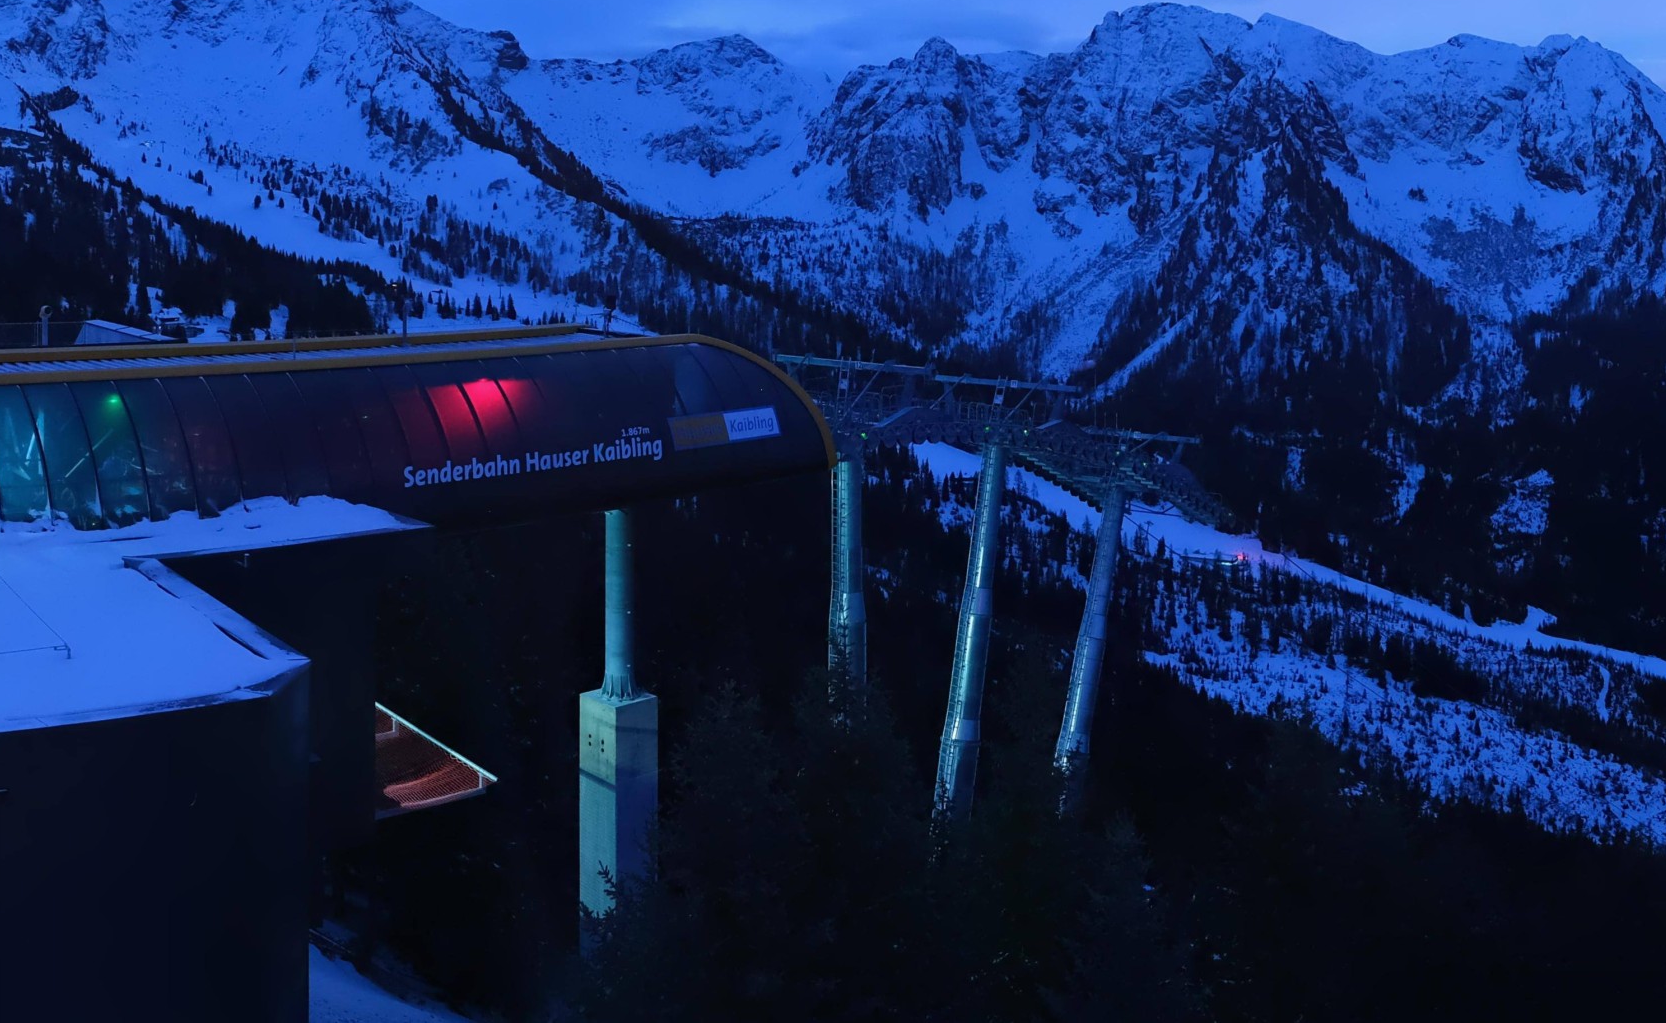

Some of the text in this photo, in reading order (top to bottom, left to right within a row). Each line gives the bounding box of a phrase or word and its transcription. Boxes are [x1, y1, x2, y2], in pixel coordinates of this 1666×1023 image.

[621, 426, 650, 437] 1.867m
[729, 416, 774, 433] Kaibling
[403, 437, 663, 488] Senderbahn Hauser Kaibling
